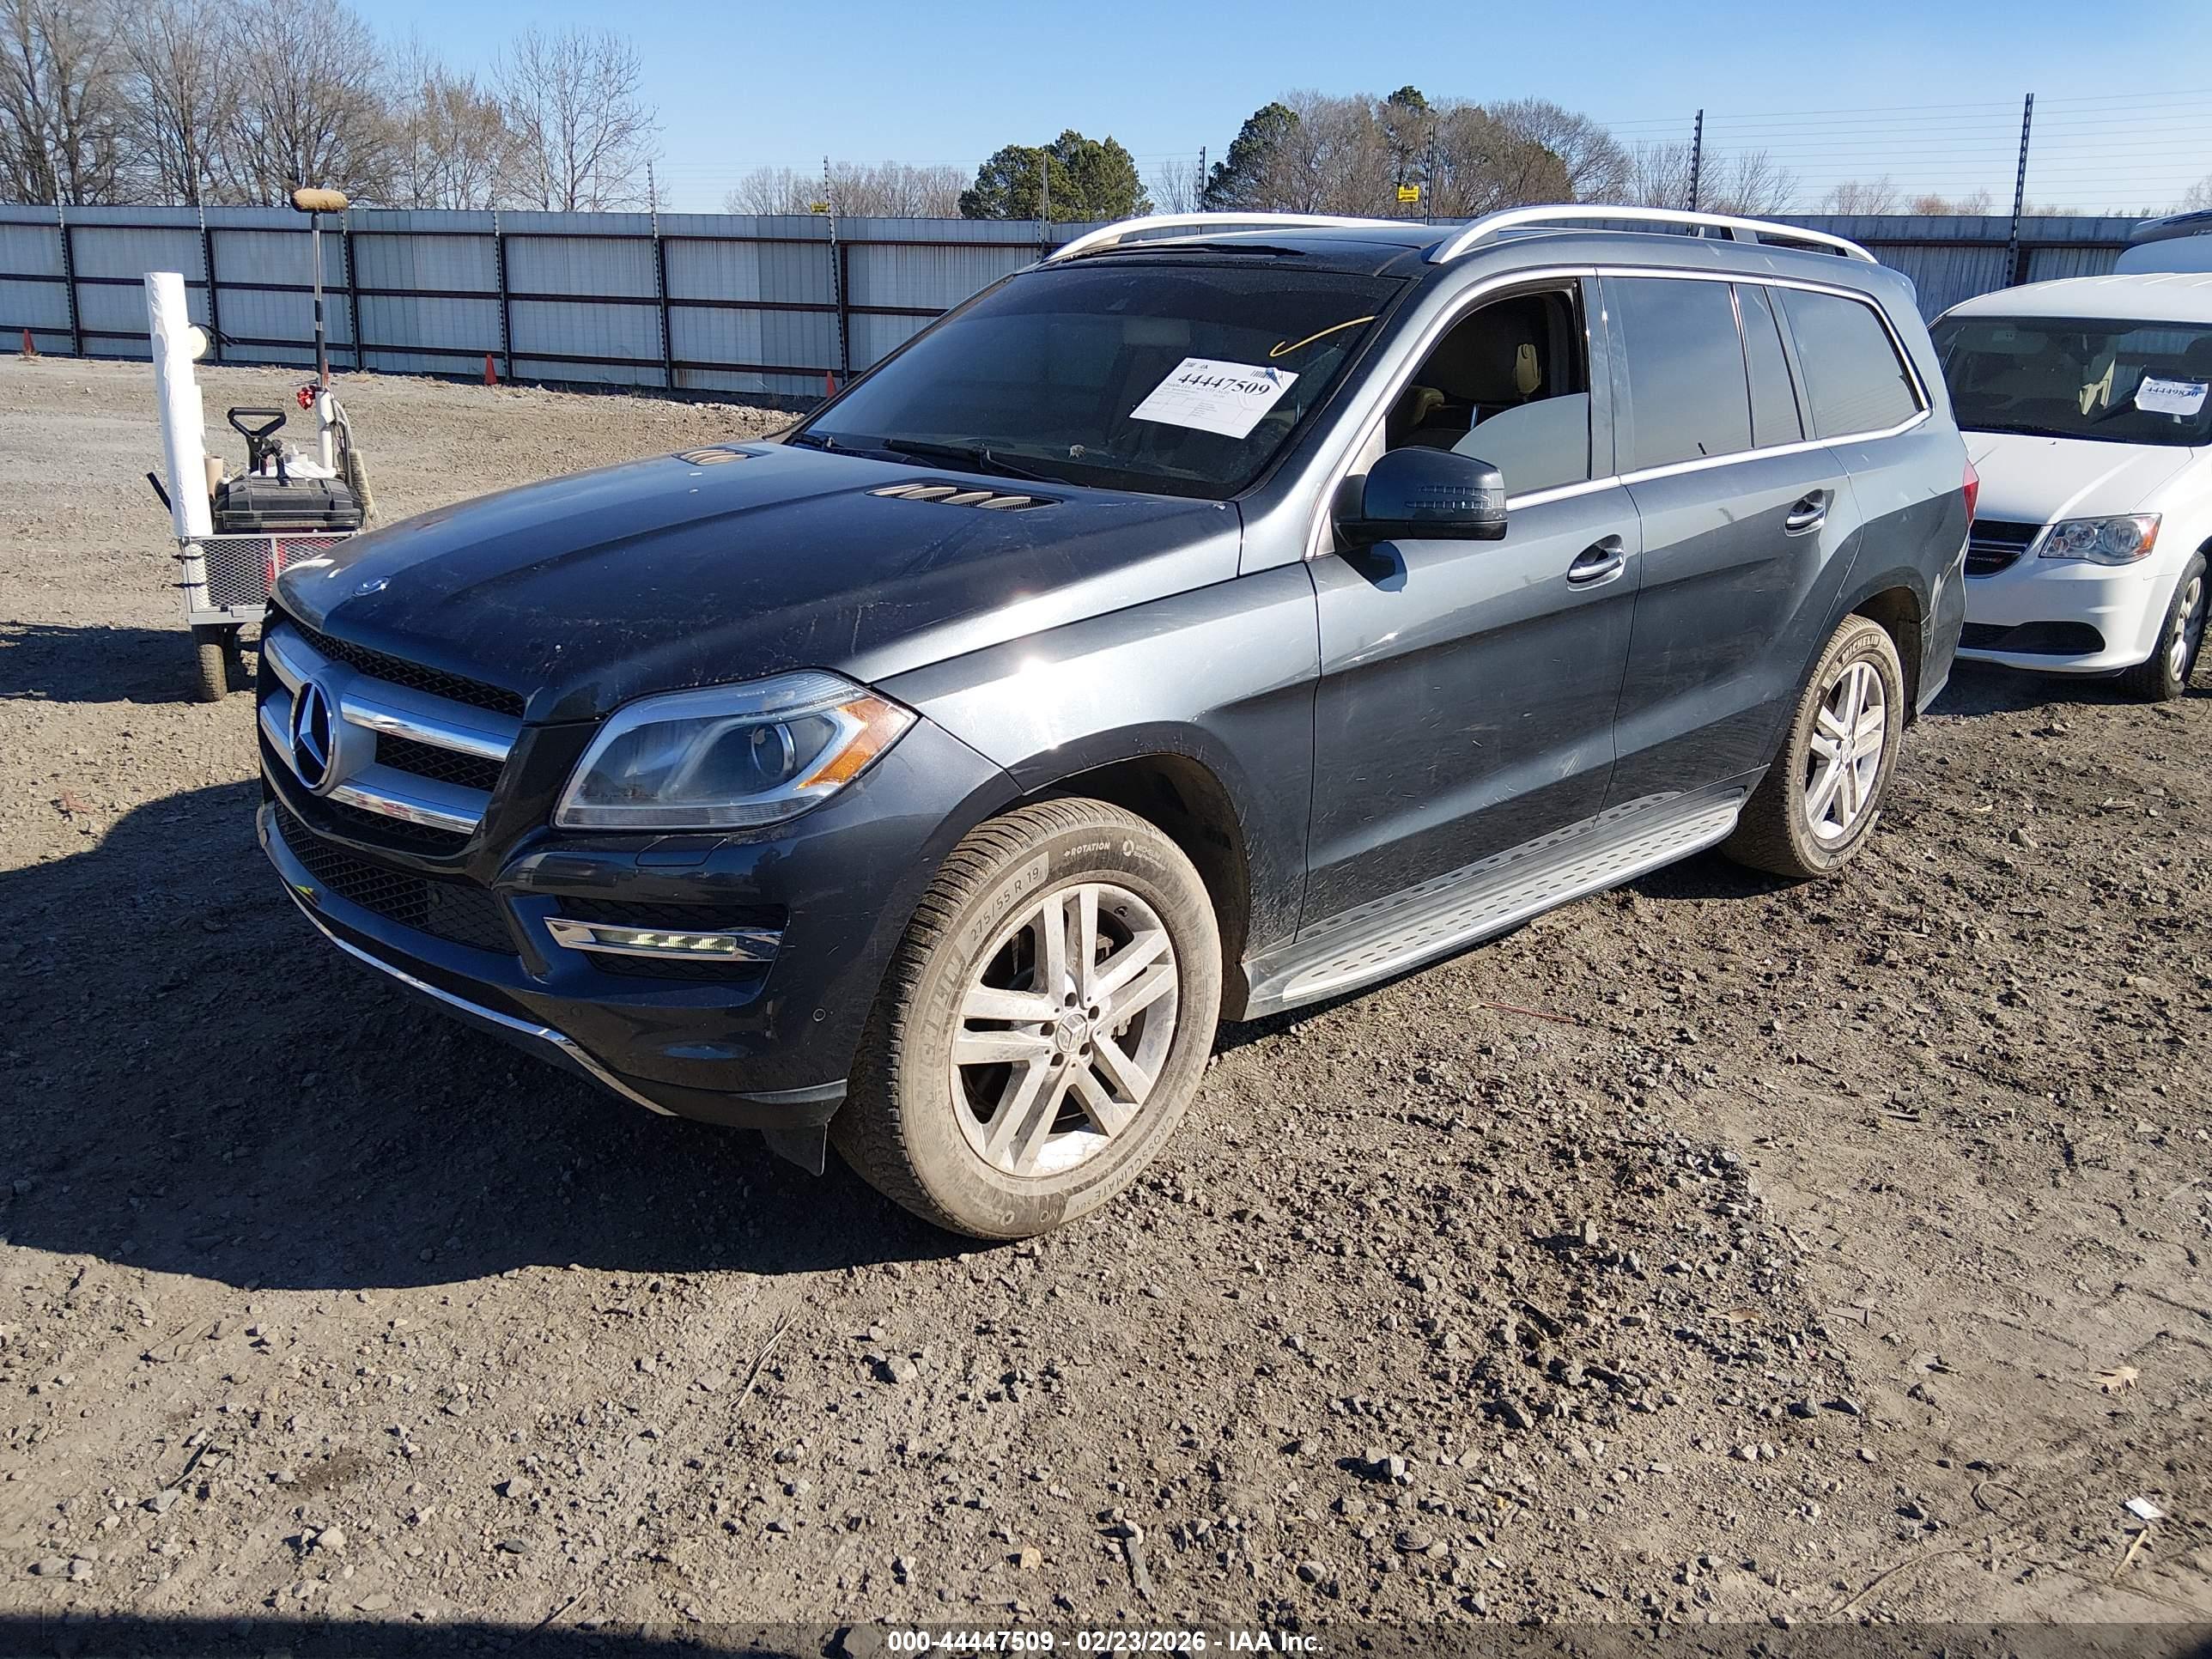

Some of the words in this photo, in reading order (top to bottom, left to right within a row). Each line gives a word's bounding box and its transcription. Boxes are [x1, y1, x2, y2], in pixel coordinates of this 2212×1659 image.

[1177, 372, 1271, 396] 44447509
[1841, 634, 1881, 664] MICHELIN
[1071, 842, 1111, 857] ROTATION
[970, 889, 1012, 942] 275/55
[1014, 879, 1023, 893] R
[1026, 866, 1040, 884] 19
[1092, 1115, 1175, 1201] CROSSCLIMATE
[1039, 1208, 1059, 1224] MO
